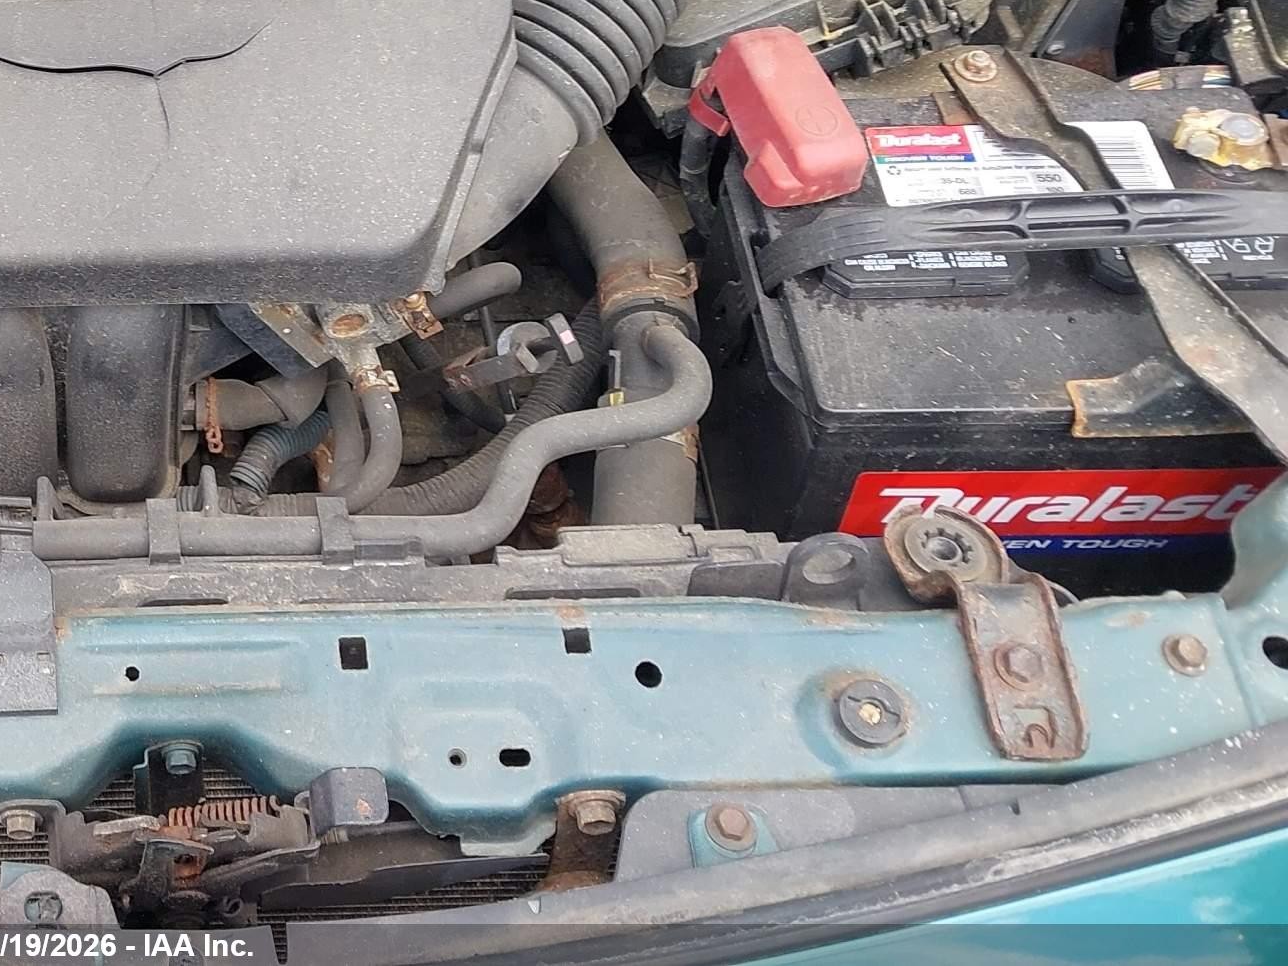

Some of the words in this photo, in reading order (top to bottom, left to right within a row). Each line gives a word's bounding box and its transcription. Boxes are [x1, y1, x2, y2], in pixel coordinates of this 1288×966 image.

[874, 132, 962, 147] Duralast
[1036, 174, 1062, 183] 550
[879, 484, 1263, 525] Duralast
[1061, 538, 1169, 550] TOUGH
